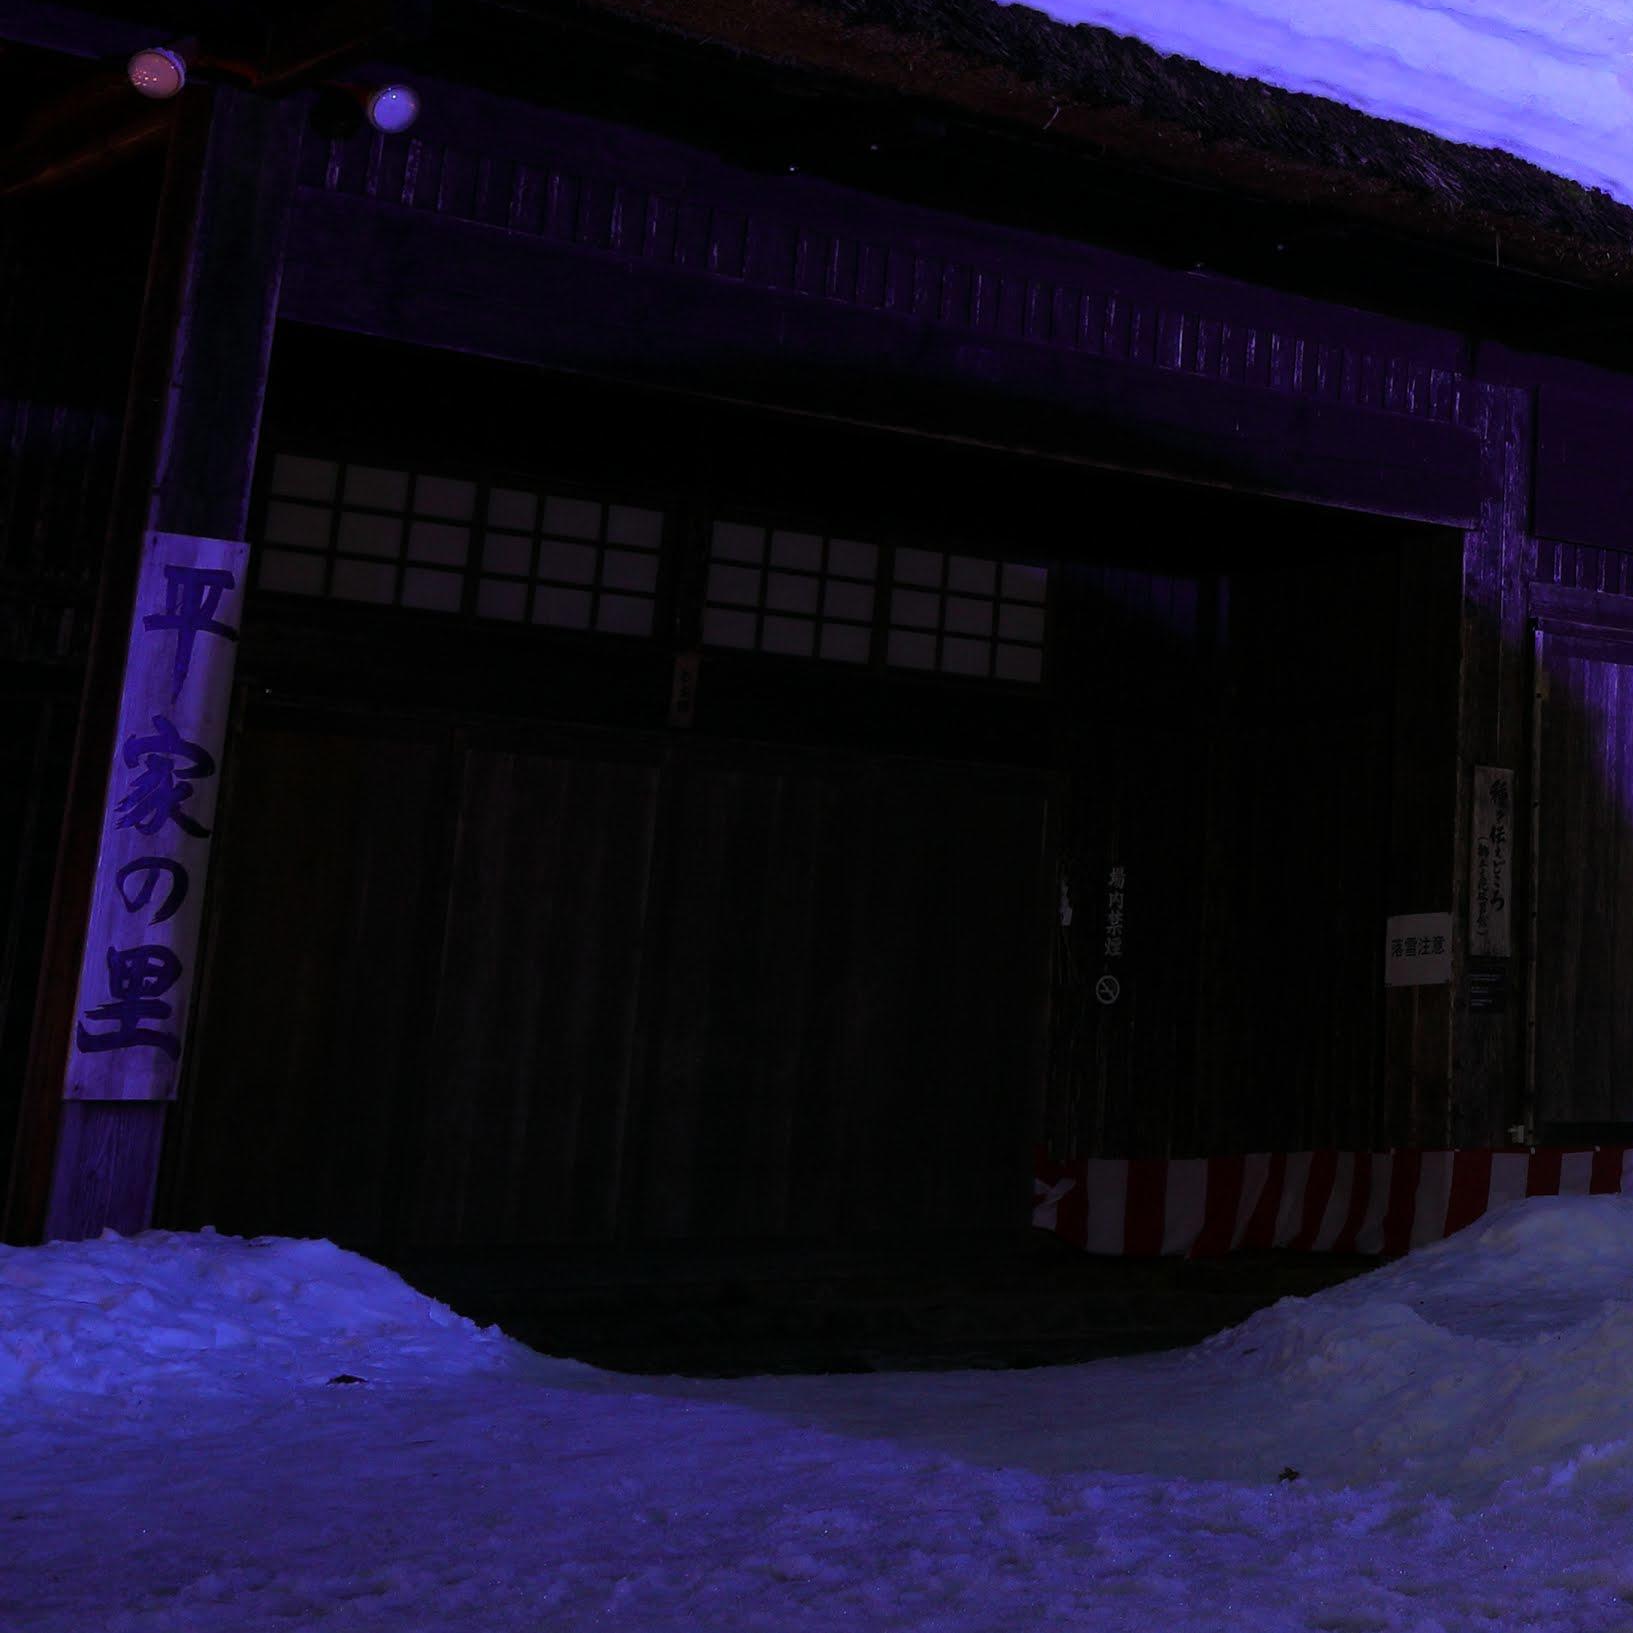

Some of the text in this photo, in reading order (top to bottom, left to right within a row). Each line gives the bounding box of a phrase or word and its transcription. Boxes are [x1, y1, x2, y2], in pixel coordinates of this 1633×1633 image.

[76, 562, 239, 1060] 平家の里
[1103, 866, 1127, 959] 場内禁煙
[1391, 936, 1446, 957] 落雪注意
